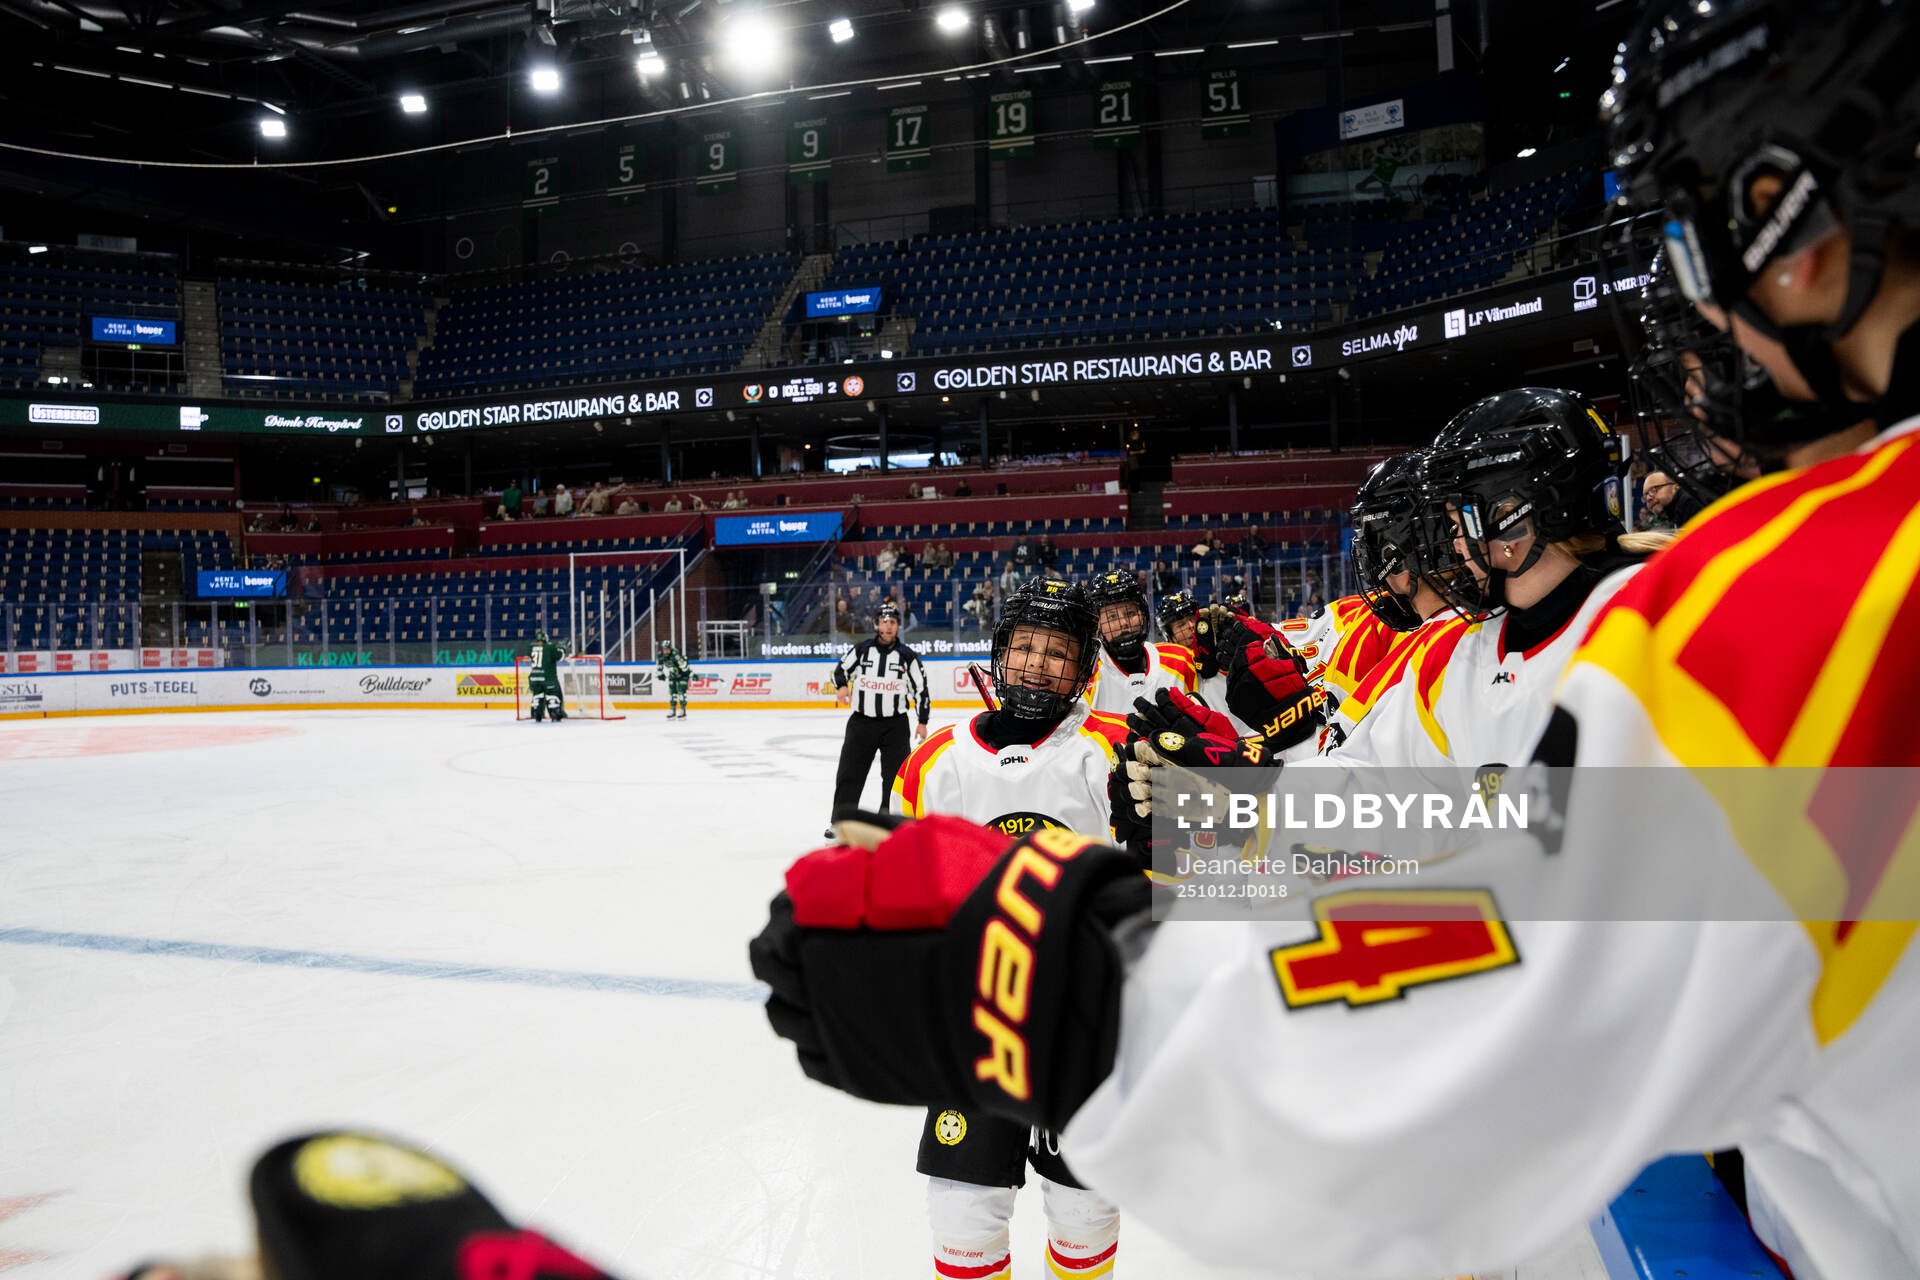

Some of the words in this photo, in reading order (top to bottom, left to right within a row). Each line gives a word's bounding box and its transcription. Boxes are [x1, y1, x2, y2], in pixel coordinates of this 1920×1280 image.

[1099, 93, 1132, 124] 21
[1208, 81, 1240, 112] 51
[895, 116, 922, 147] 17
[996, 102, 1026, 135] 19
[709, 143, 725, 170] 9
[803, 130, 818, 158] 9
[534, 167, 550, 196] 2
[618, 154, 635, 183] 5
[1468, 312, 1484, 327] LF
[1484, 297, 1542, 323] Värmland
[1342, 332, 1391, 356] SELMA
[1392, 325, 1418, 351] spa
[933, 365, 1016, 389] GOLDEN
[1020, 362, 1068, 384] STAR
[1073, 353, 1202, 380] RESTAURANG
[1208, 351, 1224, 372] &
[1230, 349, 1272, 371] BAR
[768, 386, 778, 398] 0
[827, 382, 837, 394] 2
[264, 415, 304, 427] Dömle
[304, 416, 363, 432] Herrgård
[417, 409, 480, 431] GOLDEN
[483, 405, 519, 426] STAR
[523, 395, 625, 422] RESTAURANG
[628, 394, 642, 413] &
[645, 391, 680, 412] BAR
[780, 520, 808, 531] bauer
[244, 575, 273, 586] bauer
[762, 640, 812, 656] Nordens
[935, 636, 953, 652] för
[111, 682, 148, 697] PUTS
[153, 681, 199, 695] TEGEL
[360, 674, 432, 695] Bulldozer
[859, 677, 901, 691] Scandic
[991, 817, 1034, 835] 1912
[1268, 886, 1522, 1011] 4
